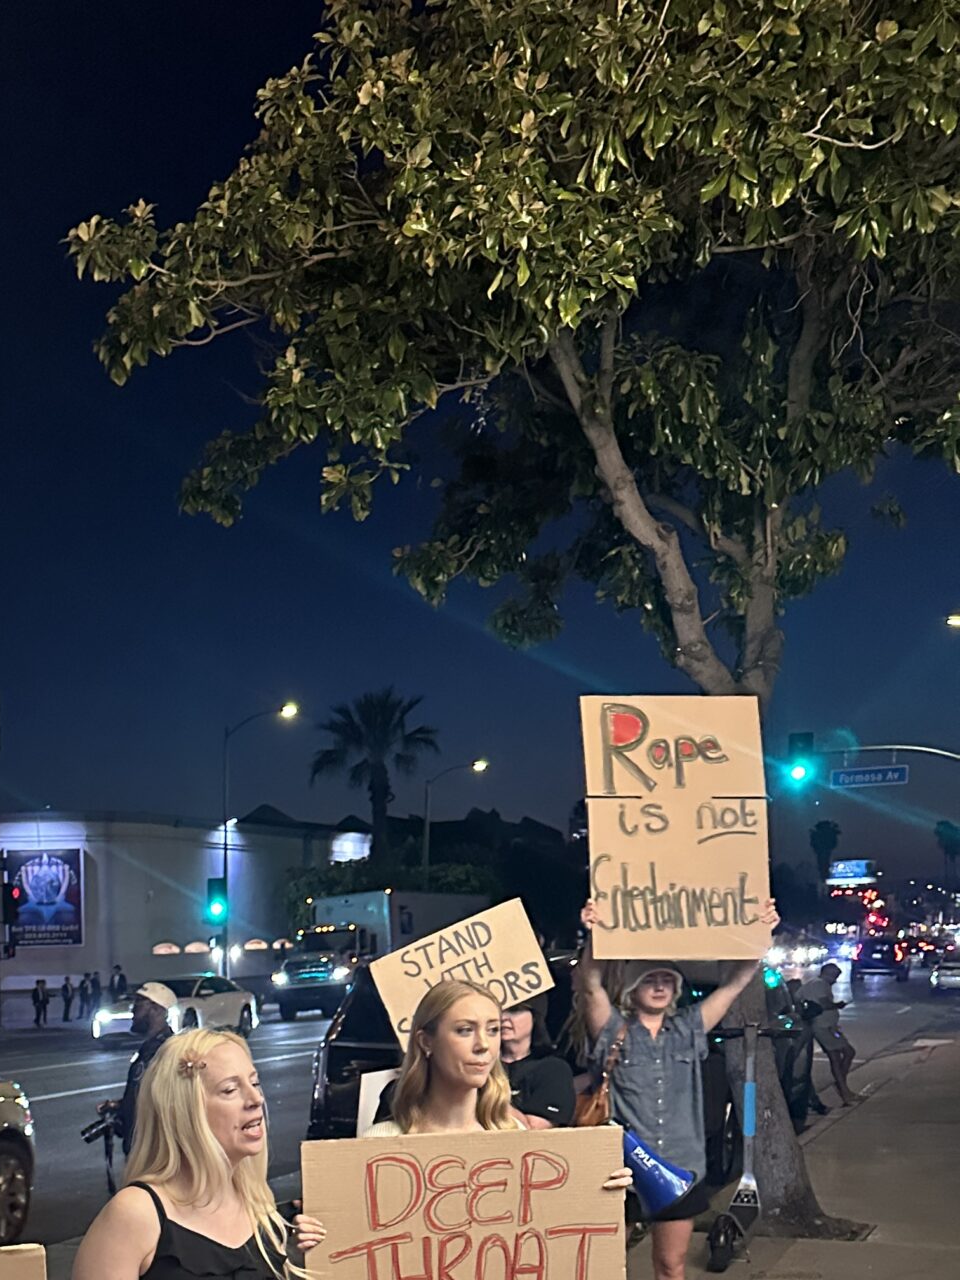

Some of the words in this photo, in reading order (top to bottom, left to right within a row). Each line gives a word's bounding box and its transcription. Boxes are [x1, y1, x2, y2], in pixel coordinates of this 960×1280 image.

[600, 703, 729, 794] Rape
[618, 803, 670, 836] is
[696, 800, 758, 830] not
[400, 921, 493, 977] STAND
[633, 1146, 657, 1168] PYLE
[365, 1151, 570, 1232] DEEP
